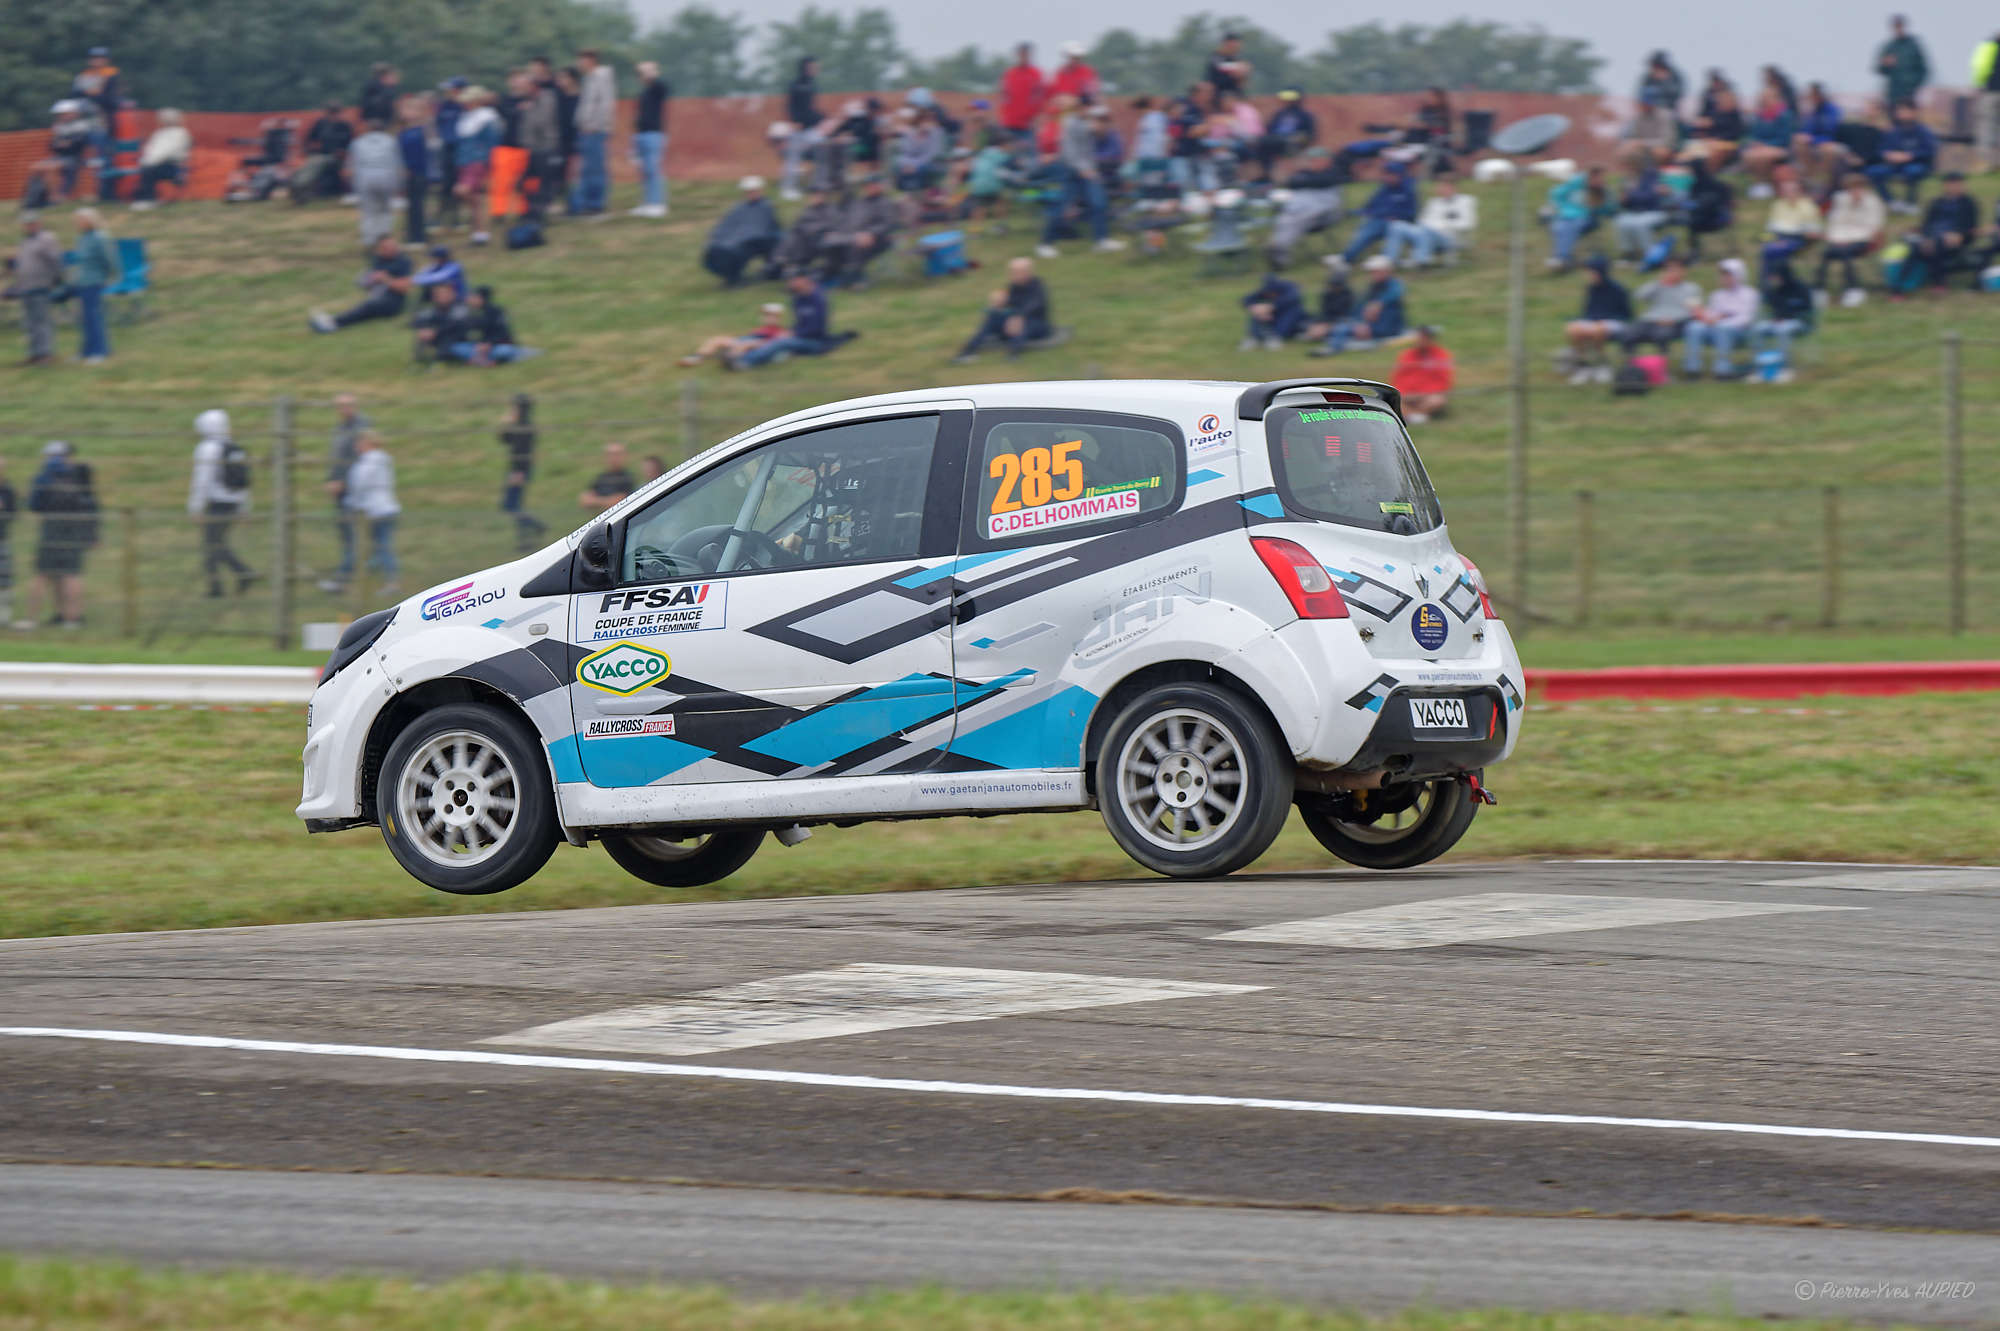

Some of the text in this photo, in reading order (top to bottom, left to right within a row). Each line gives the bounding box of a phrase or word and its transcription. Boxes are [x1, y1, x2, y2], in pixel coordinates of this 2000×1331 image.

[989, 439, 1084, 515] 285
[991, 492, 1137, 533] C.DELHOMMAIS
[441, 587, 506, 618] GARIOU
[599, 586, 698, 613] FFSA
[595, 610, 704, 630] COUPE DE FRANCE
[589, 657, 662, 681] YACCO
[1414, 700, 1464, 726] YACCO
[589, 719, 673, 735] RALLYCROSS FRANCE
[920, 780, 1073, 796] www.gaetanjanautomobiles.fr
